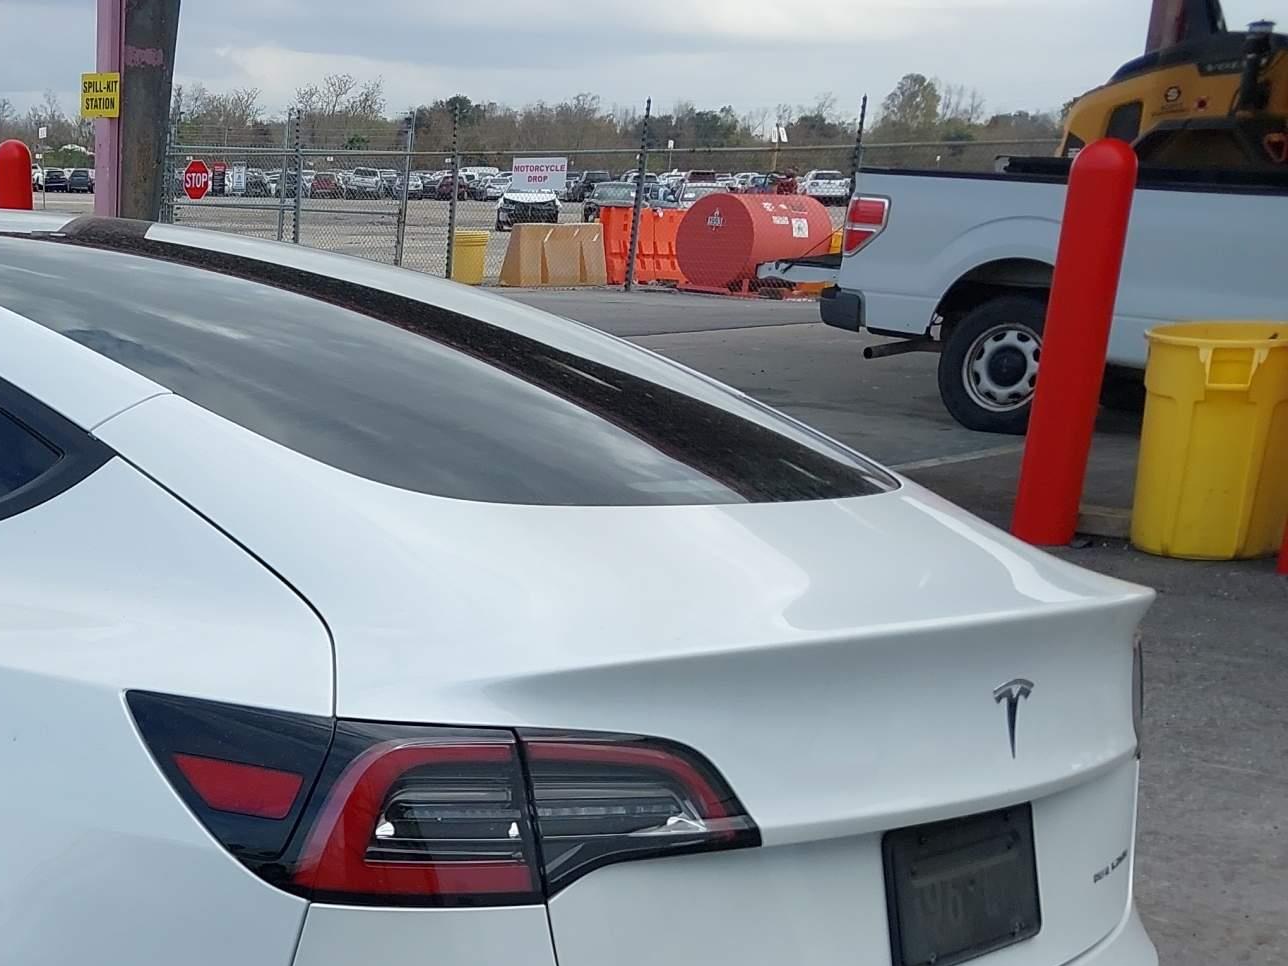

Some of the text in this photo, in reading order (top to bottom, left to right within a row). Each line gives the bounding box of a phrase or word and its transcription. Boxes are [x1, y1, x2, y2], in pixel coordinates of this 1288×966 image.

[83, 80, 118, 93] SPILL-KIT
[85, 97, 115, 110] STATION
[513, 164, 565, 173] MOTORCYCLE
[185, 173, 208, 188] STOP
[527, 175, 548, 183] DROP
